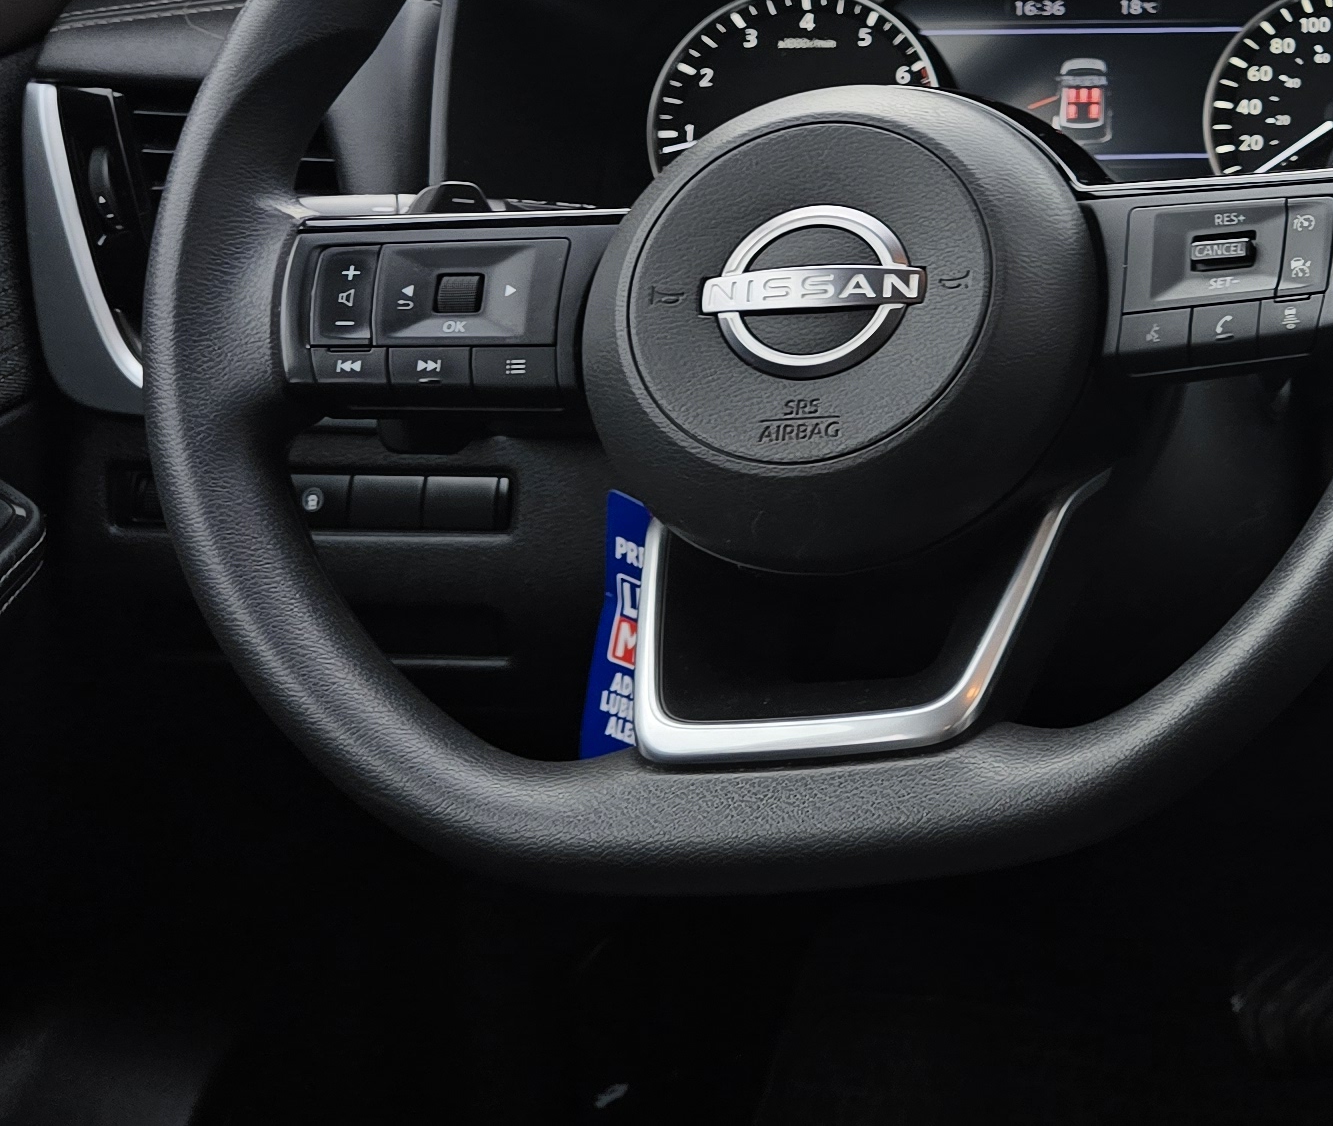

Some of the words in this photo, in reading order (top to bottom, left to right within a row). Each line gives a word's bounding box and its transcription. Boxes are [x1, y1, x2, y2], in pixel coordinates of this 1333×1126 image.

[1015, 0, 1066, 16] 16:36
[799, 12, 815, 31] 4
[1299, 17, 1331, 33] 100
[743, 28, 758, 48] 3
[857, 27, 873, 47] 5
[1269, 38, 1296, 54] 80
[699, 68, 714, 87] 2
[895, 66, 911, 84] 6
[1247, 65, 1273, 82] 60
[1235, 99, 1263, 115] 40
[684, 124, 694, 141] 1
[1238, 134, 1264, 151] 20
[1214, 212, 1246, 226] RES+
[1194, 241, 1244, 257] CANCEL
[707, 273, 920, 308] NISSAN
[442, 320, 468, 333] OK
[784, 398, 821, 416] SRS
[757, 420, 841, 443] AIRBAG
